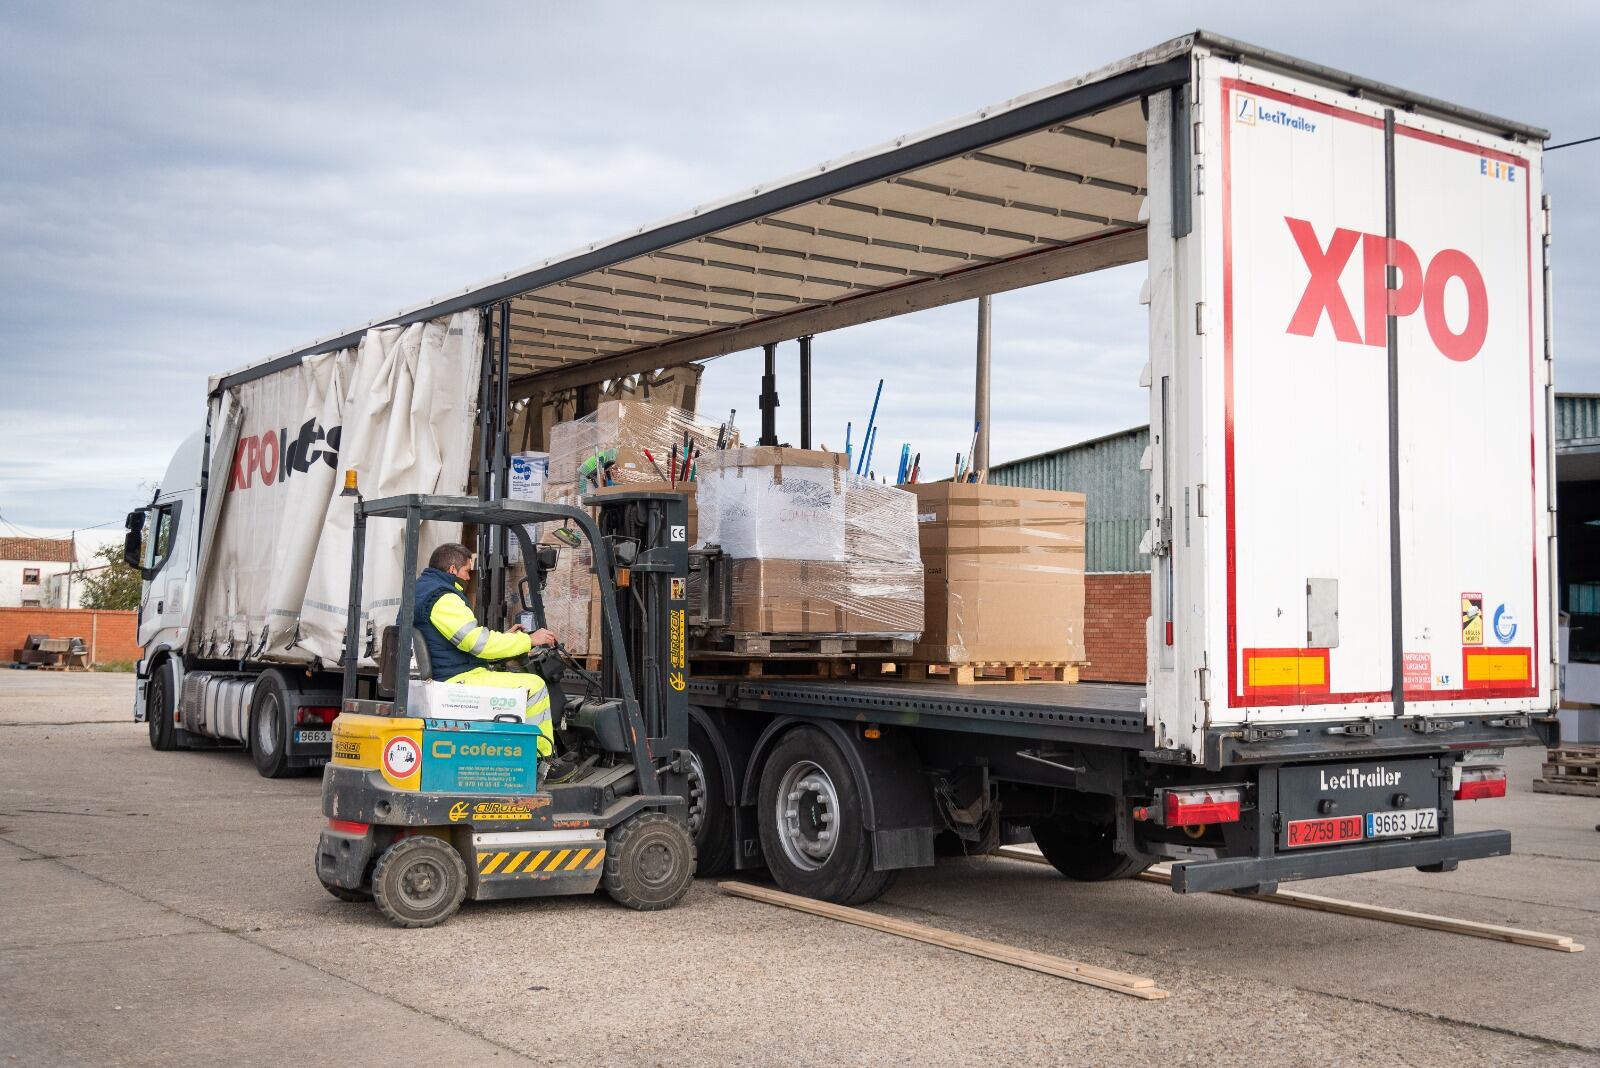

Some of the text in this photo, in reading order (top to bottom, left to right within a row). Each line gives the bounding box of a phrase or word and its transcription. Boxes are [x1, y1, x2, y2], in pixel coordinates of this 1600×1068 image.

[1258, 105, 1316, 133] LeciTrailer
[1284, 215, 1489, 362] XPO
[671, 528, 685, 539] CE
[301, 731, 327, 741] 9663
[396, 744, 407, 752] 1m
[460, 742, 522, 757] cofersa
[1320, 766, 1401, 791] LeciTrailer
[1289, 818, 1362, 843] R 2759 BDJ
[1375, 812, 1435, 833] 9663 JZZ
